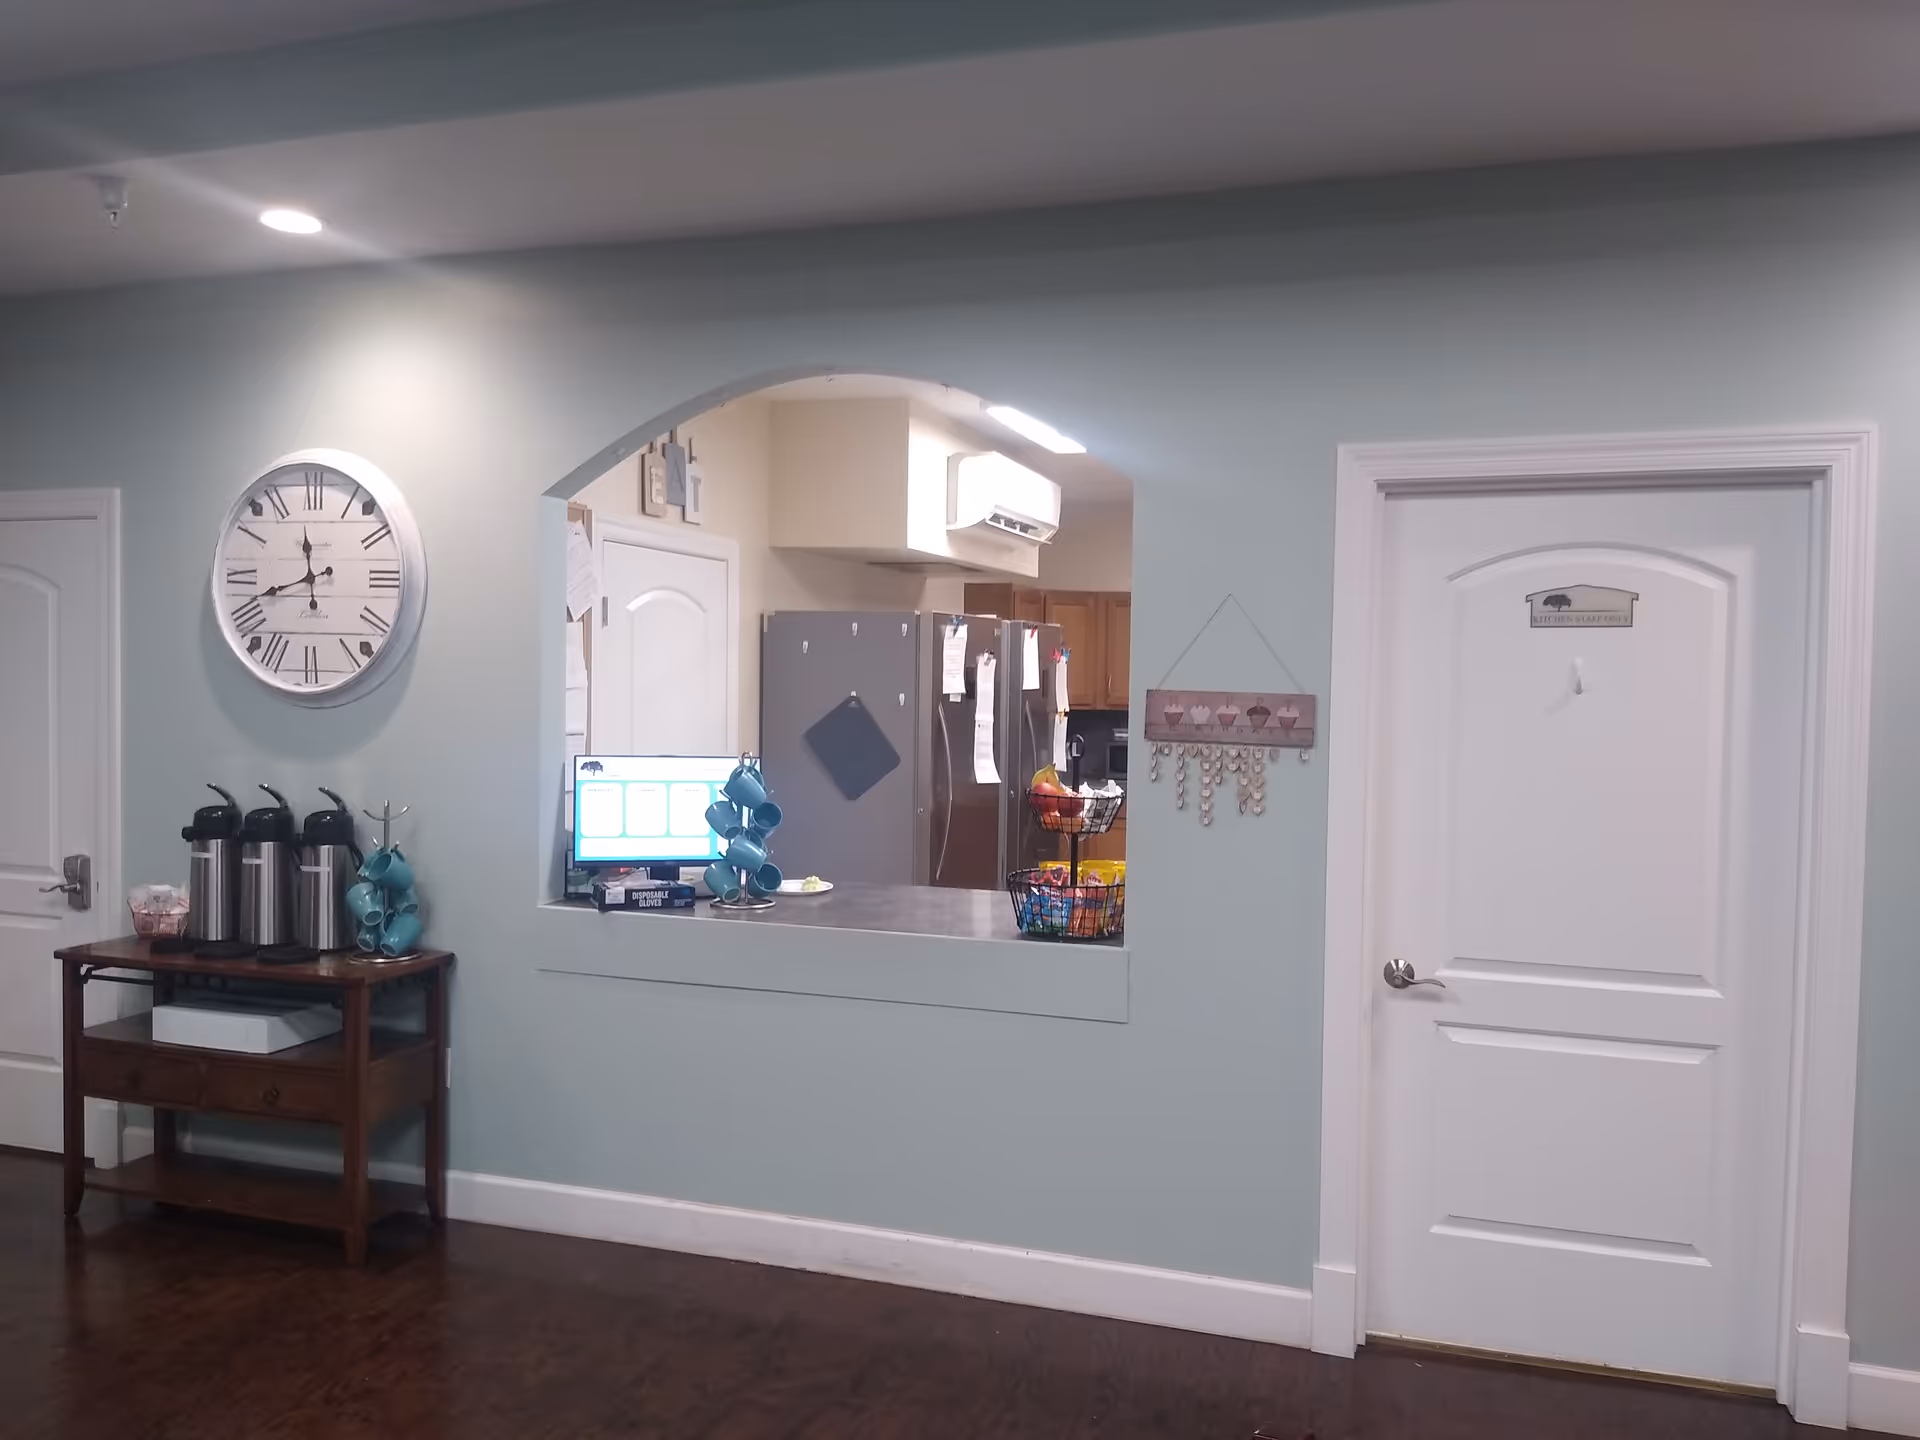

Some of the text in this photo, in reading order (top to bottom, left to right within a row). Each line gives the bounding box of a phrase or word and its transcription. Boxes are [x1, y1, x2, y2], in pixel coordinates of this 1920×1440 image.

[303, 471, 324, 511] XII
[264, 484, 290, 524] XI
[361, 523, 391, 551] II
[369, 570, 400, 589] III
[632, 891, 669, 900] DISPOSABLE
[639, 898, 662, 907] GLOVES
